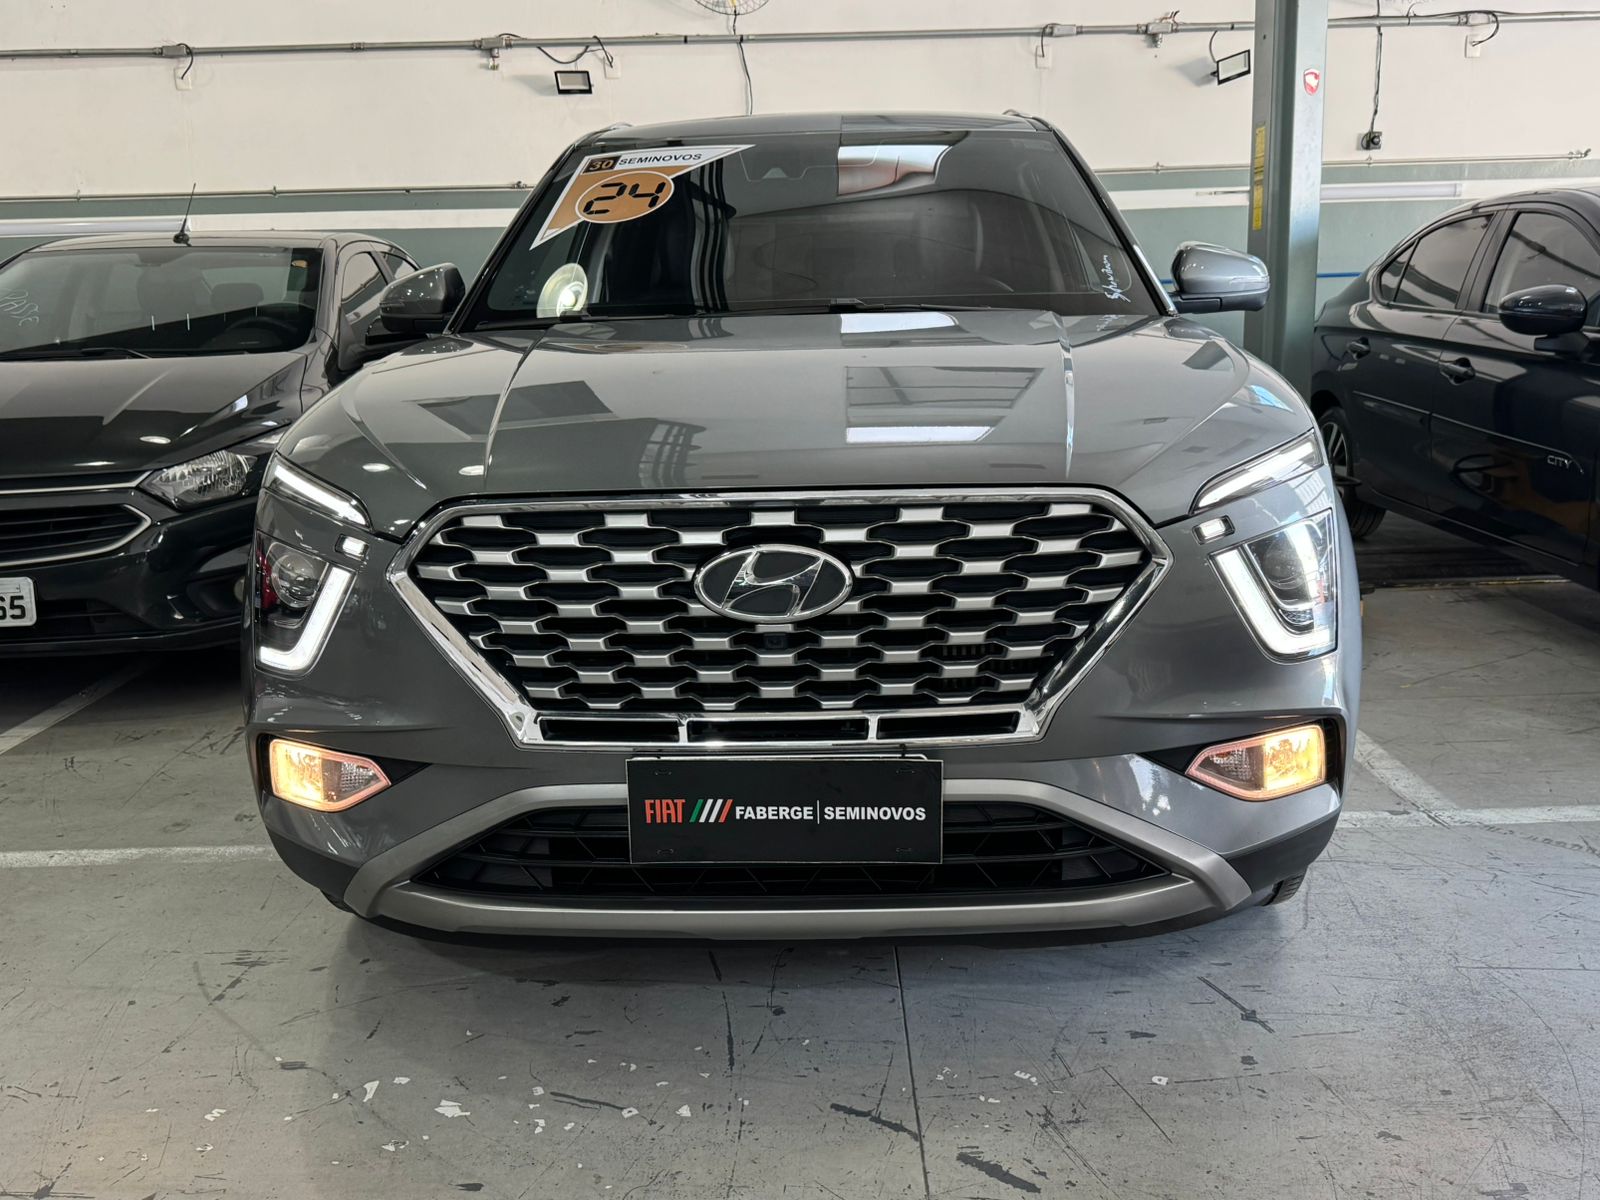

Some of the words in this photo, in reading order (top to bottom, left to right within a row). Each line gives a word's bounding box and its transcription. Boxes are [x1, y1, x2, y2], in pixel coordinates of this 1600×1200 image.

[619, 153, 702, 165] SEMINOVOS
[583, 182, 667, 215] 24
[1547, 455, 1572, 468] CITY
[644, 799, 686, 823] FIAT
[735, 806, 814, 820] FABERGE
[823, 806, 927, 821] SEMINOVOS
